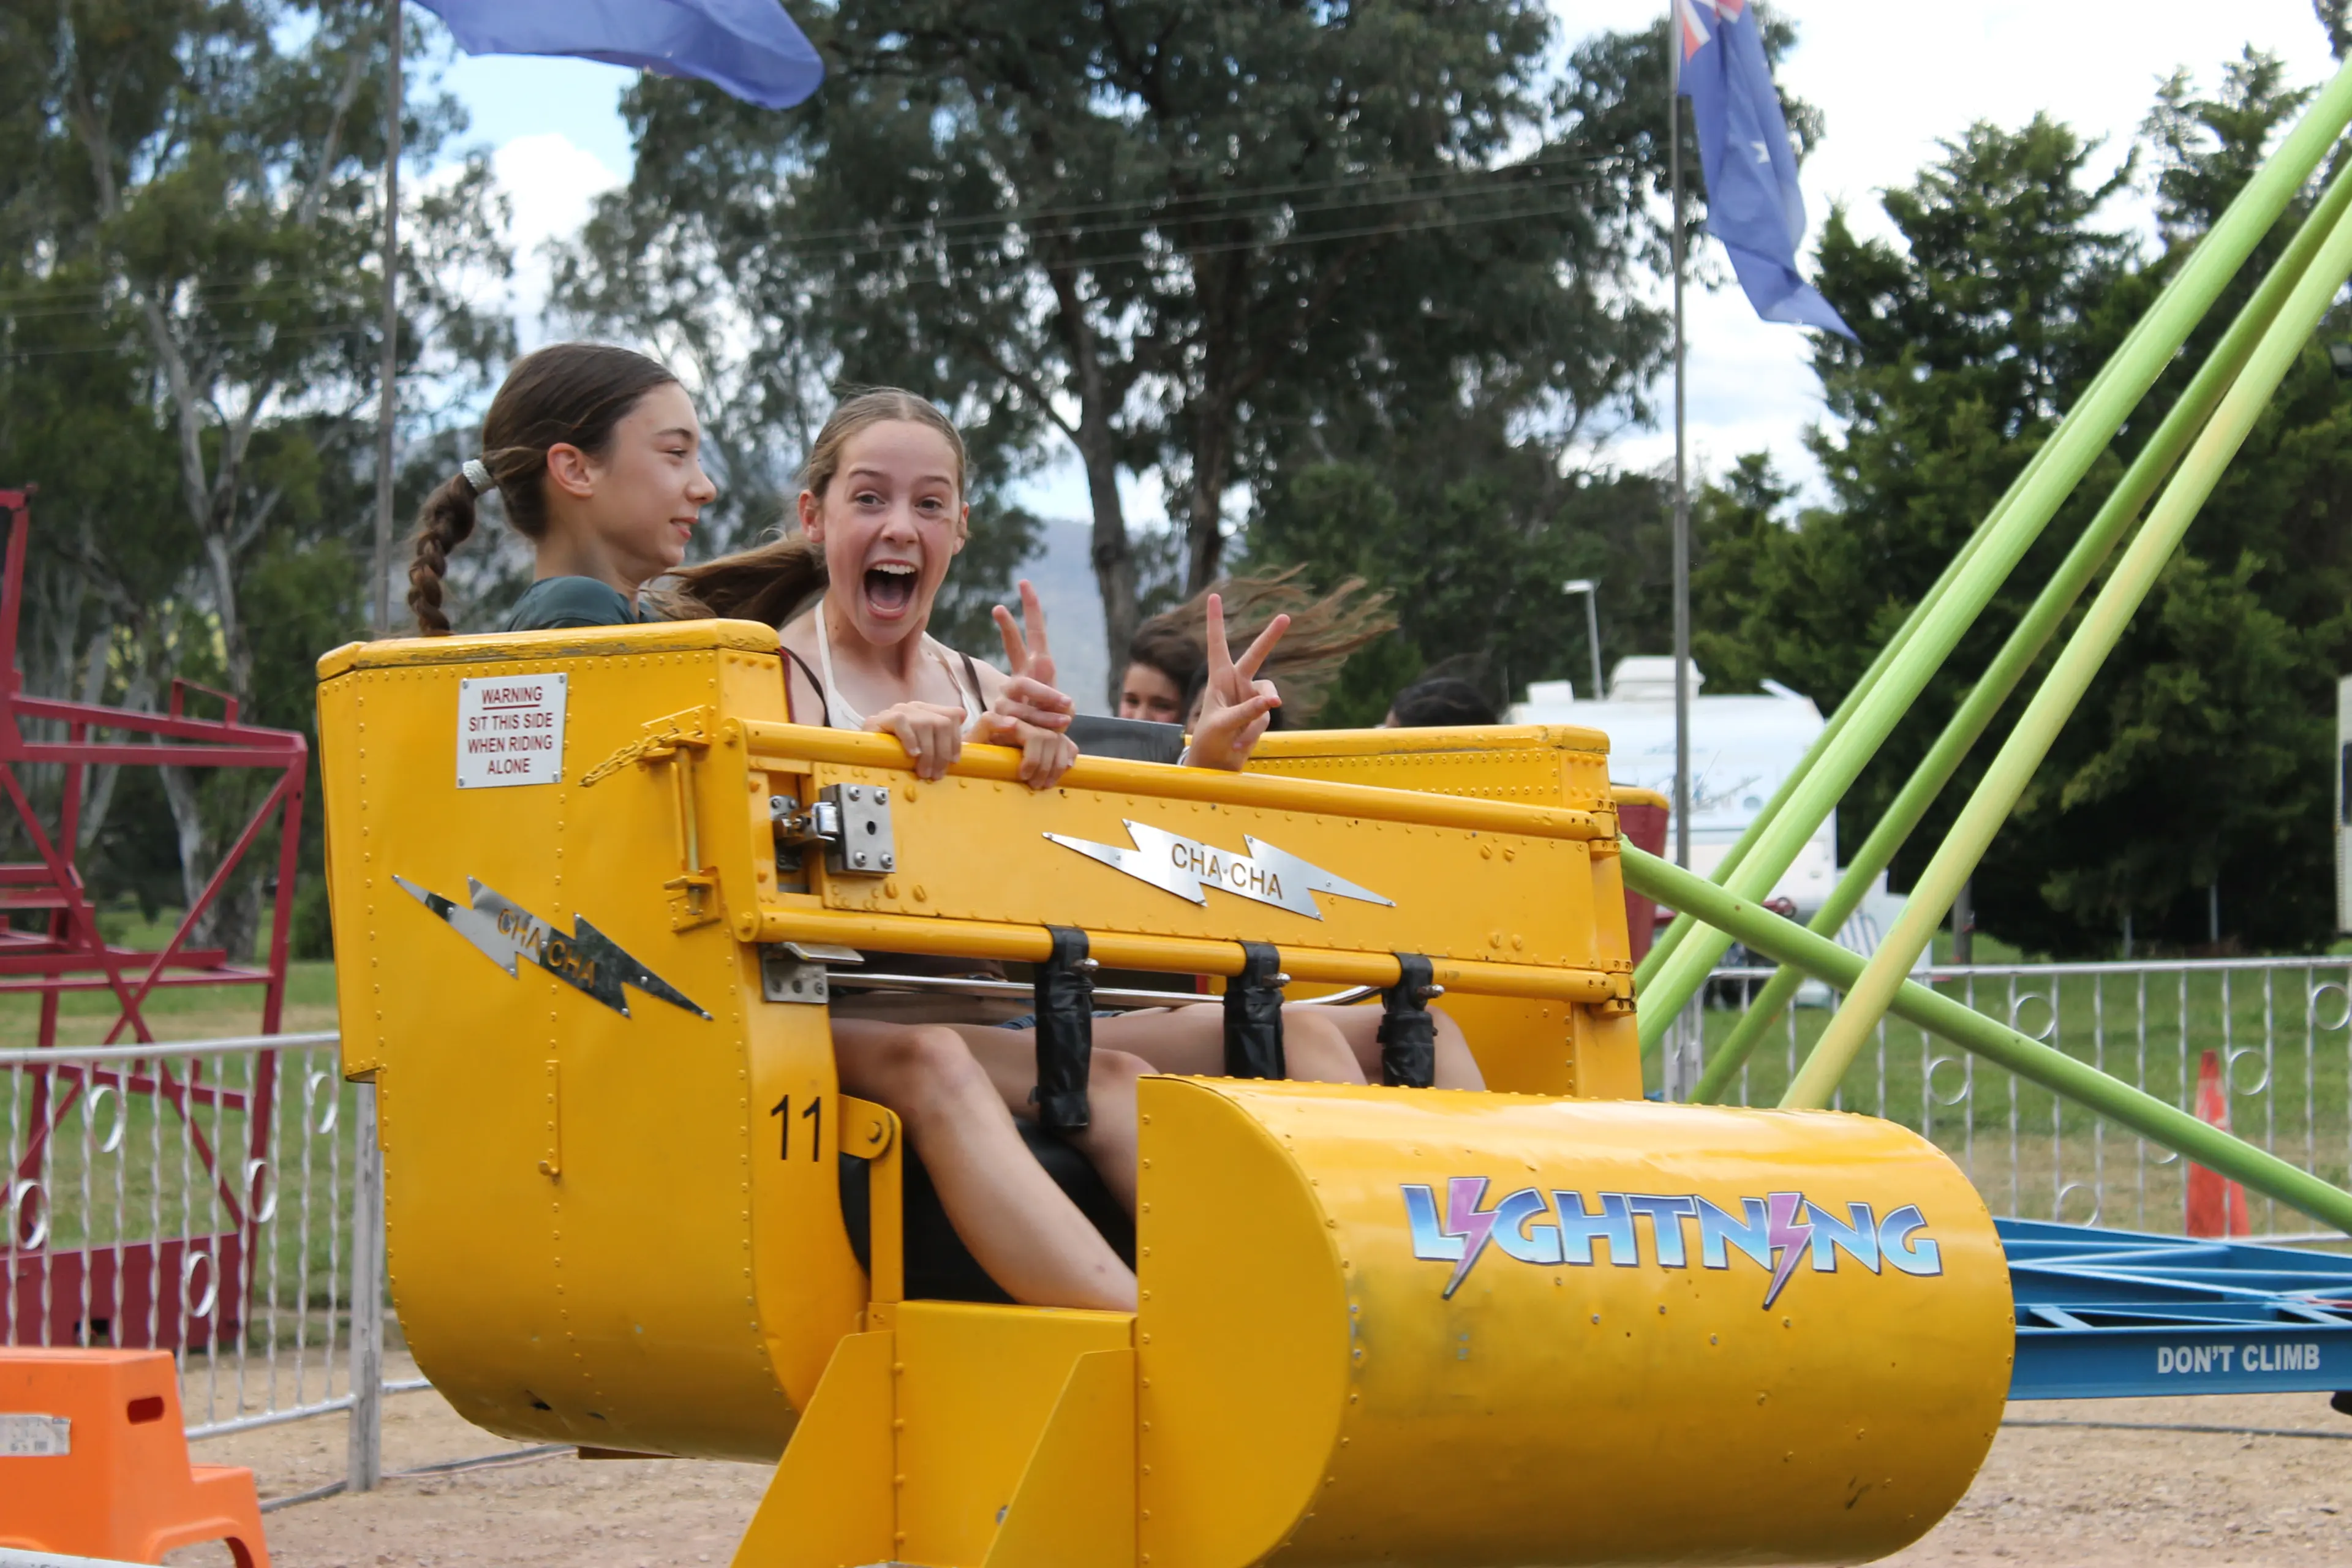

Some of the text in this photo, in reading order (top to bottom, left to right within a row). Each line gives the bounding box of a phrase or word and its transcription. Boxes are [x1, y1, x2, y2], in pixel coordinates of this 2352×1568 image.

[481, 686, 543, 704] WARNING
[469, 712, 553, 731] SIT THIS SIDE
[468, 734, 552, 753] WHEN RIDING
[486, 758, 530, 775] ALONE
[771, 1094, 821, 1163] 11
[1400, 1177, 1943, 1310] LIGHTNING
[2157, 1344, 2320, 1374] DON'T CLIMB
